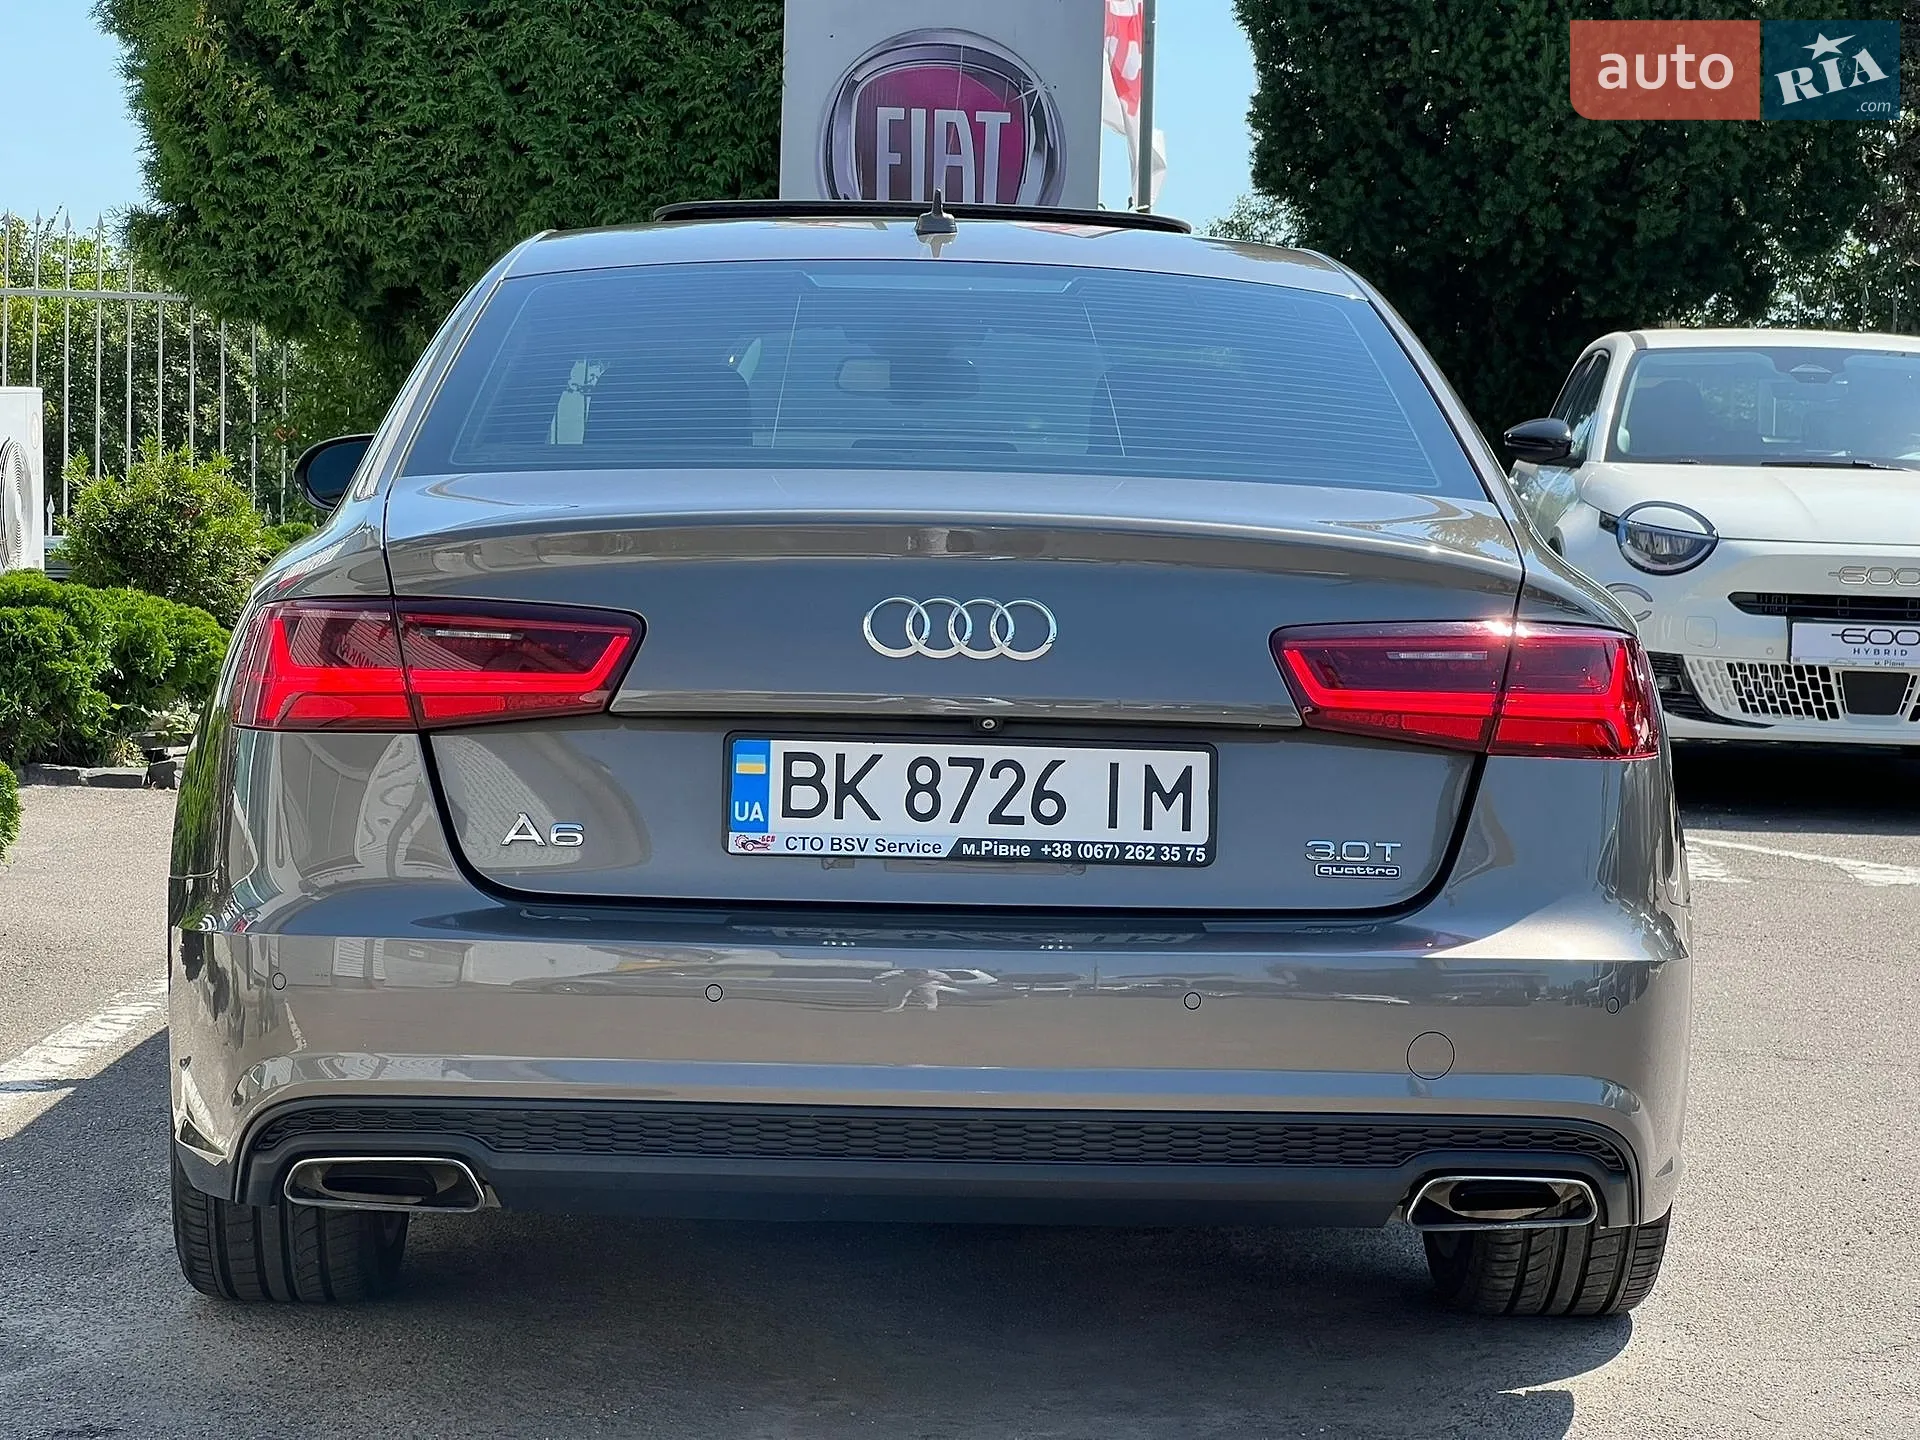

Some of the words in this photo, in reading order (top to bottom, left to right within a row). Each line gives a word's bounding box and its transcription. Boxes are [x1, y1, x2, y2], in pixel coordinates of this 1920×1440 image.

[875, 106, 1012, 204] FIAT
[1853, 648, 1908, 657] HYBRID
[781, 751, 883, 821] BK
[904, 756, 1067, 826] 8726
[734, 801, 765, 822] UA
[501, 812, 584, 846] A6
[830, 837, 869, 852] BSV
[874, 838, 942, 854] Service
[1041, 842, 1072, 858] +38
[1077, 843, 1120, 861] (067)
[1124, 845, 1155, 861] 262
[1160, 846, 1181, 862] 35
[1185, 847, 1206, 862] 75
[1305, 840, 1401, 861] 3.0T
[1319, 866, 1398, 876] quattro
